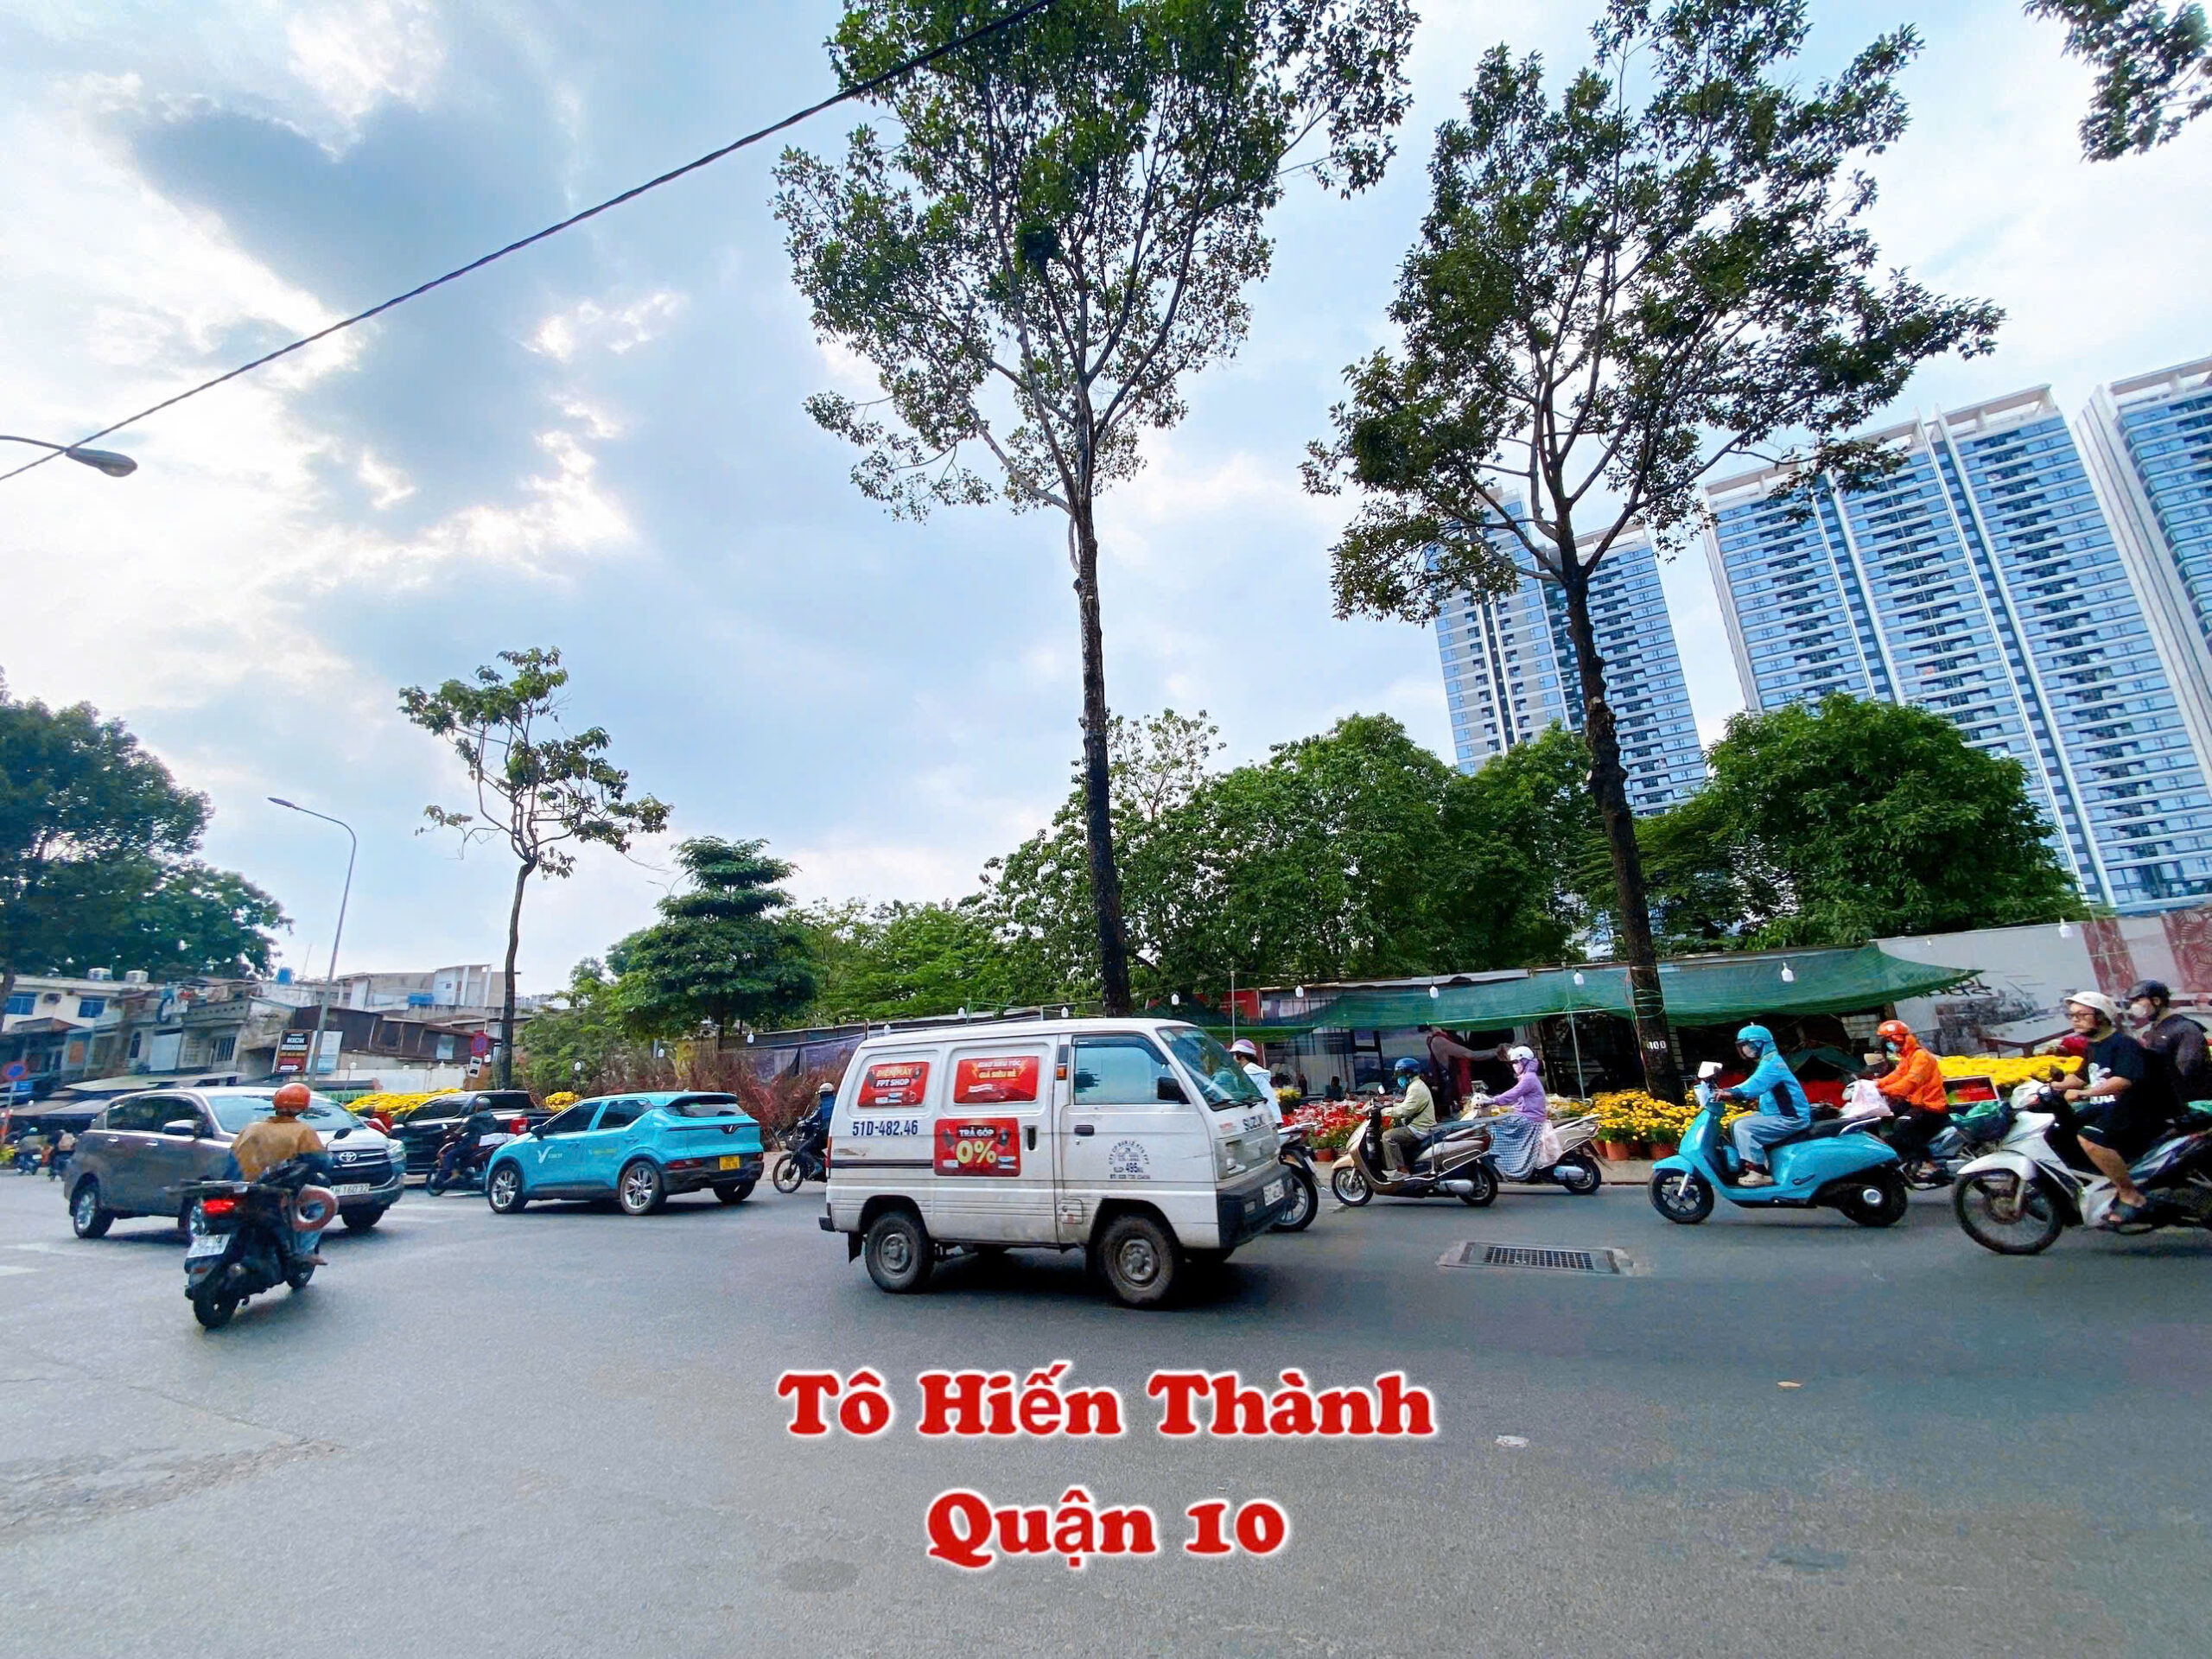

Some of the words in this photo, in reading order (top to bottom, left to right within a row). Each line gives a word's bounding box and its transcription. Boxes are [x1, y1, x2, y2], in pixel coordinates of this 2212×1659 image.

[852, 1120, 918, 1136] 51D-482.46
[958, 1126, 976, 1137] TRẢ
[976, 1127, 995, 1137] GÓP
[956, 1140, 997, 1165] 0%
